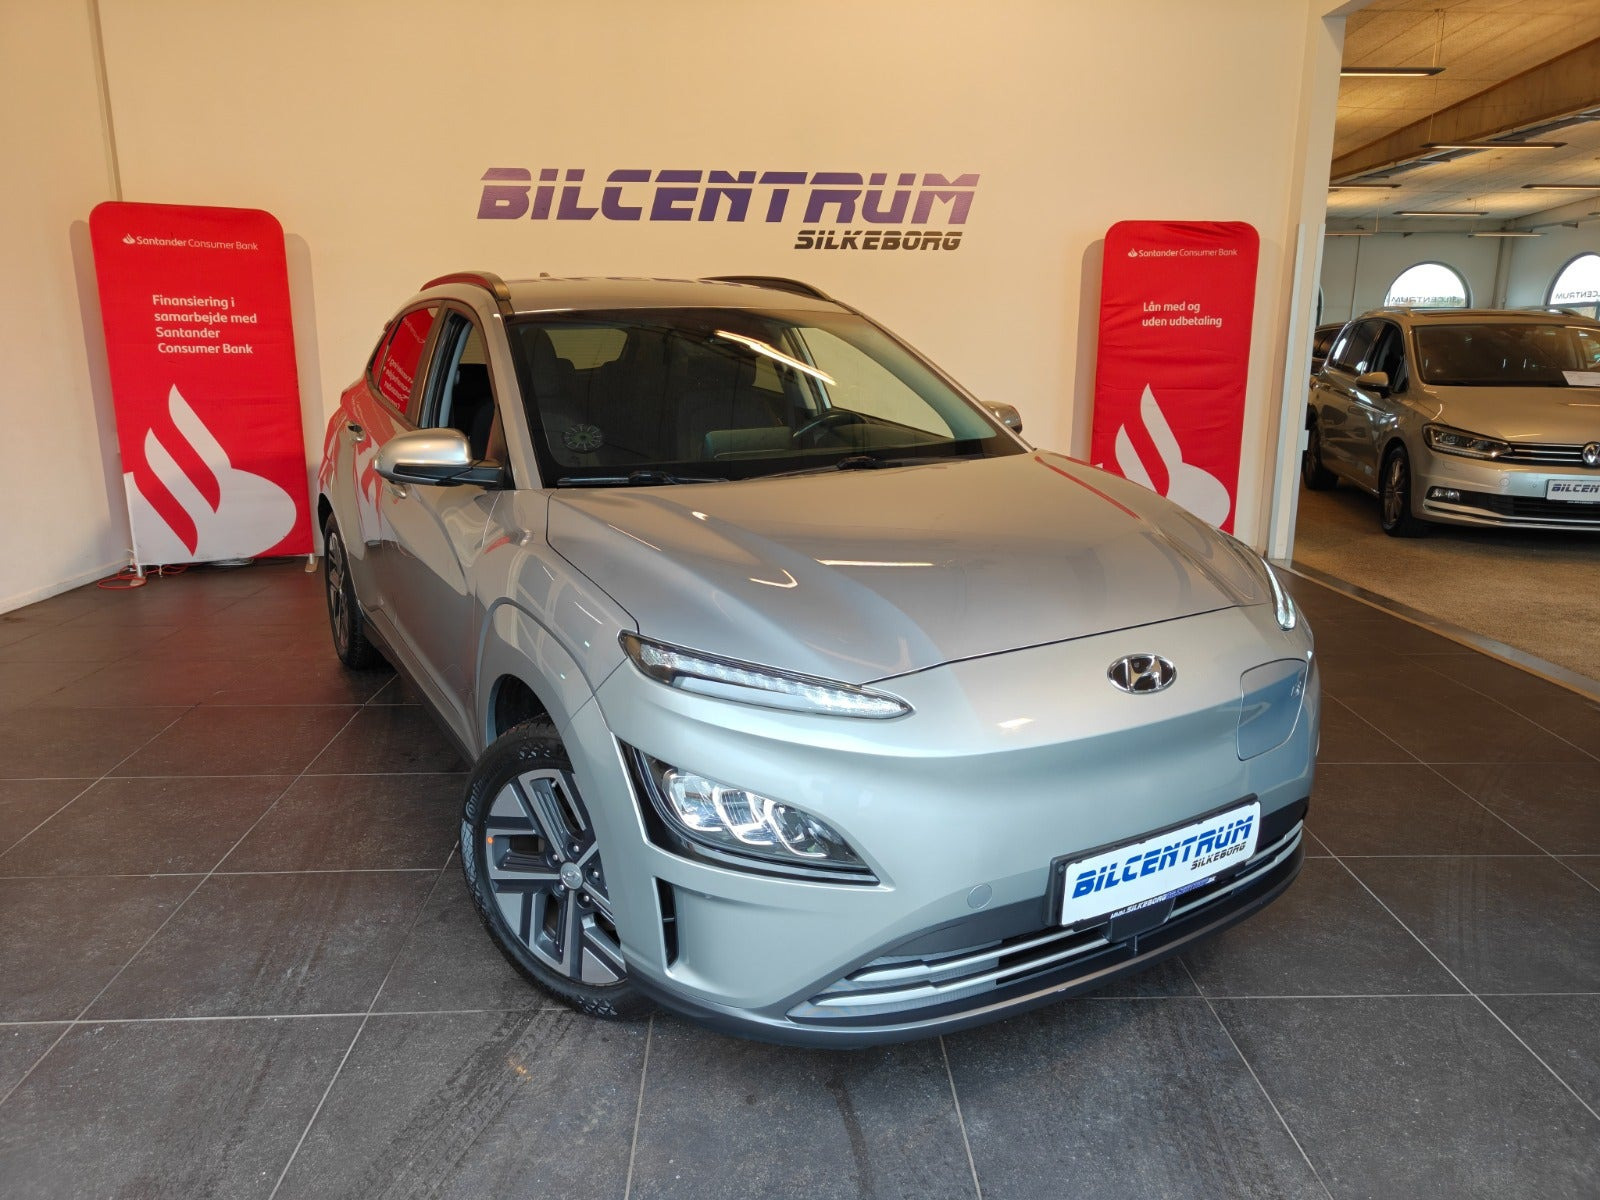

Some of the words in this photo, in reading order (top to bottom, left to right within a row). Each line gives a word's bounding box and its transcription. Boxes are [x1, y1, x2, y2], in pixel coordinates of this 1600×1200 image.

[476, 167, 980, 225] BILCENTRUM
[136, 236, 187, 247] Santander
[188, 238, 234, 249] Consumer
[236, 240, 258, 251] Bank
[794, 230, 963, 251] SILKEBORG
[1138, 249, 1179, 257] Santander
[1179, 249, 1218, 257] Consumer
[1218, 248, 1238, 257] Bank
[152, 294, 229, 310] Finansiering
[231, 296, 236, 308] i
[1143, 301, 1162, 312] Lån
[1163, 301, 1186, 312] med
[1187, 302, 1201, 313] og
[154, 311, 228, 325] samarbejde
[230, 312, 257, 324] med
[1142, 317, 1167, 327] uden
[1169, 315, 1222, 328] udbetaling
[155, 326, 220, 338] Santander
[157, 342, 220, 354] Consumer
[222, 343, 253, 354] Bank
[1071, 814, 1255, 899] BILCENTRUM
[1190, 841, 1247, 871] SILKEBORG
